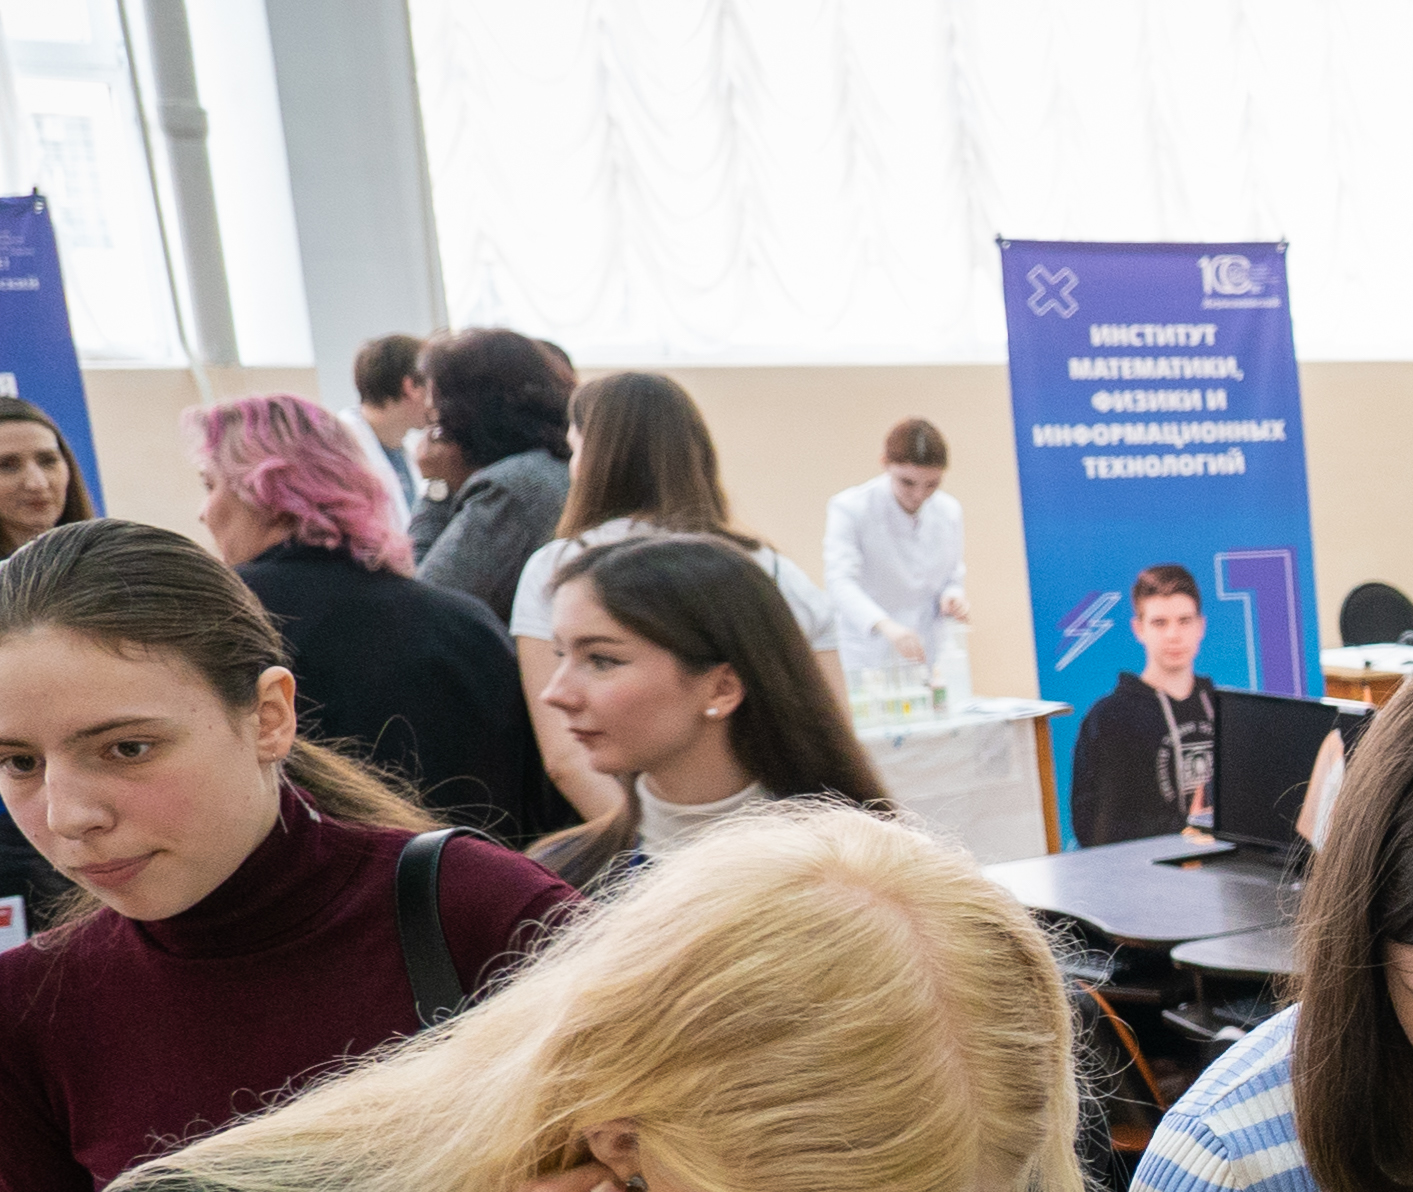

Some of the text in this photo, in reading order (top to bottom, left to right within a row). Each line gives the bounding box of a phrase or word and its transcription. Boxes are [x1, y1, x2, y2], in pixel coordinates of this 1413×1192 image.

[1090, 323, 1217, 347] ИНСТИТУТ
[1068, 356, 1244, 381] МАТЕМАТИКИ,
[1091, 388, 1227, 413] ФИЗИКИ И
[1033, 419, 1286, 449] ИНФОРМАЦИОННЫХ
[1082, 447, 1245, 479] ТЕХНОЛОГИЙ
